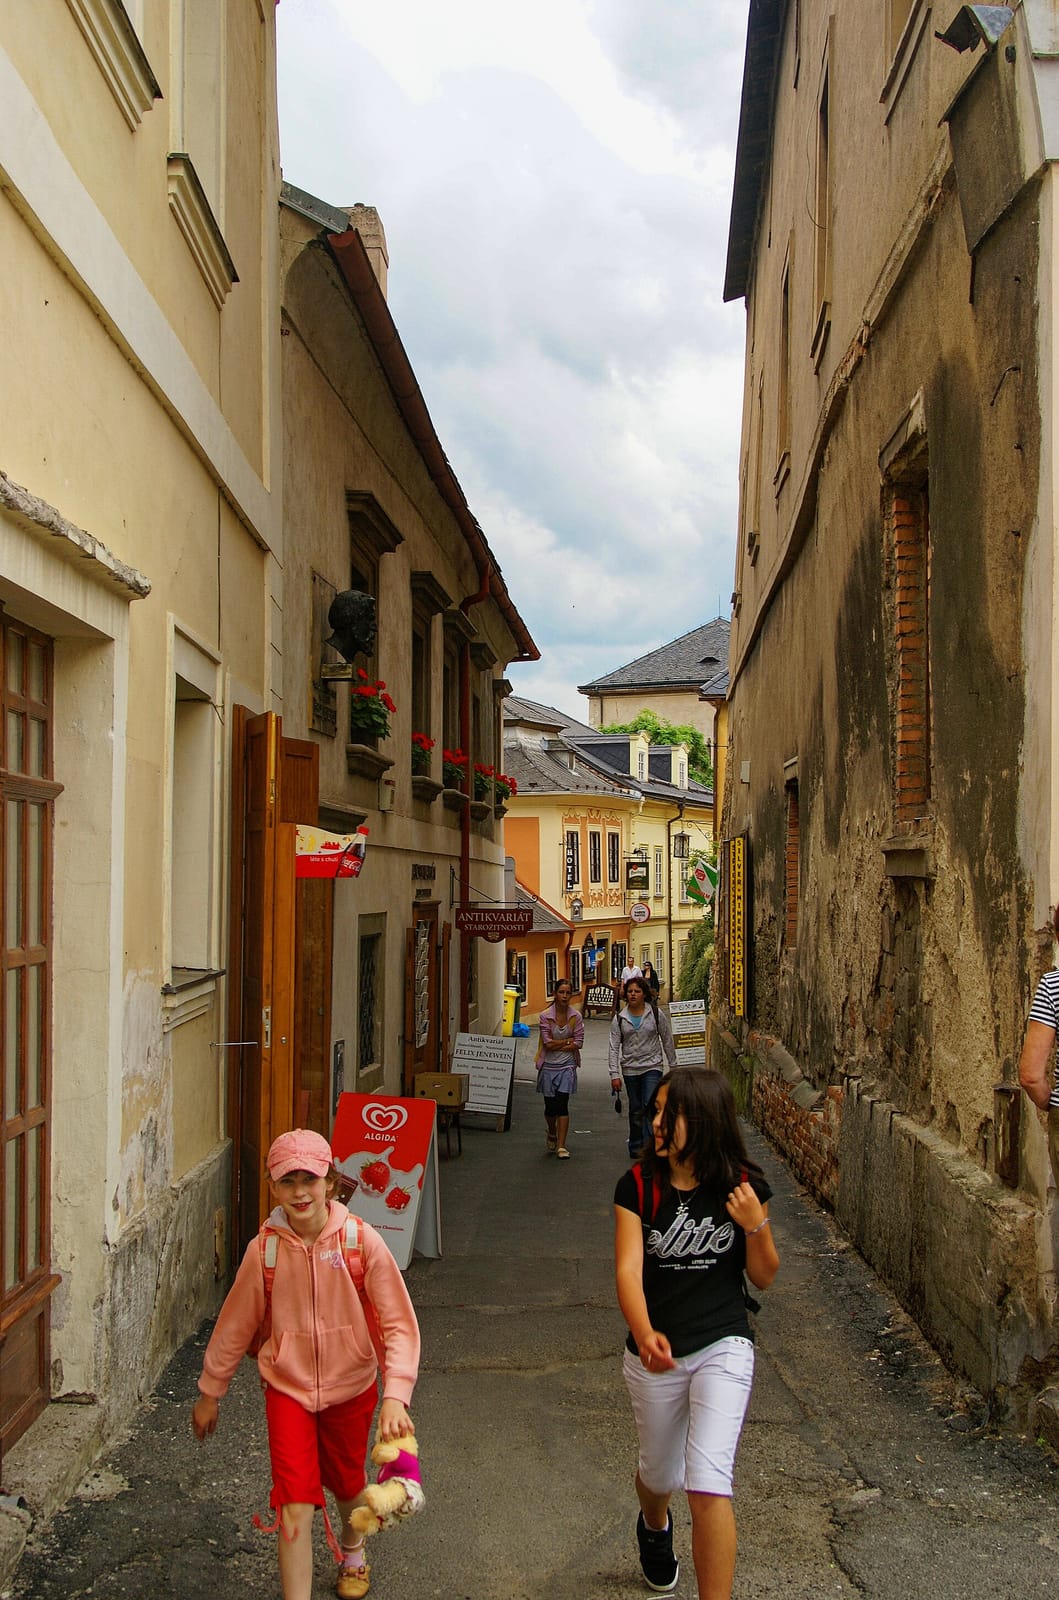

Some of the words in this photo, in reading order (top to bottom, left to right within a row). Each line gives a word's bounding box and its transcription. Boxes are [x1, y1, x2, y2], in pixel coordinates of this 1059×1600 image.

[458, 912, 531, 922] ANTIKVARIÁT
[589, 986, 614, 995] HOTEL
[456, 1048, 474, 1057] FELIX
[475, 1050, 512, 1060] JENEWEIN
[364, 1132, 396, 1142] ALGIDA
[646, 1212, 734, 1258] elite
